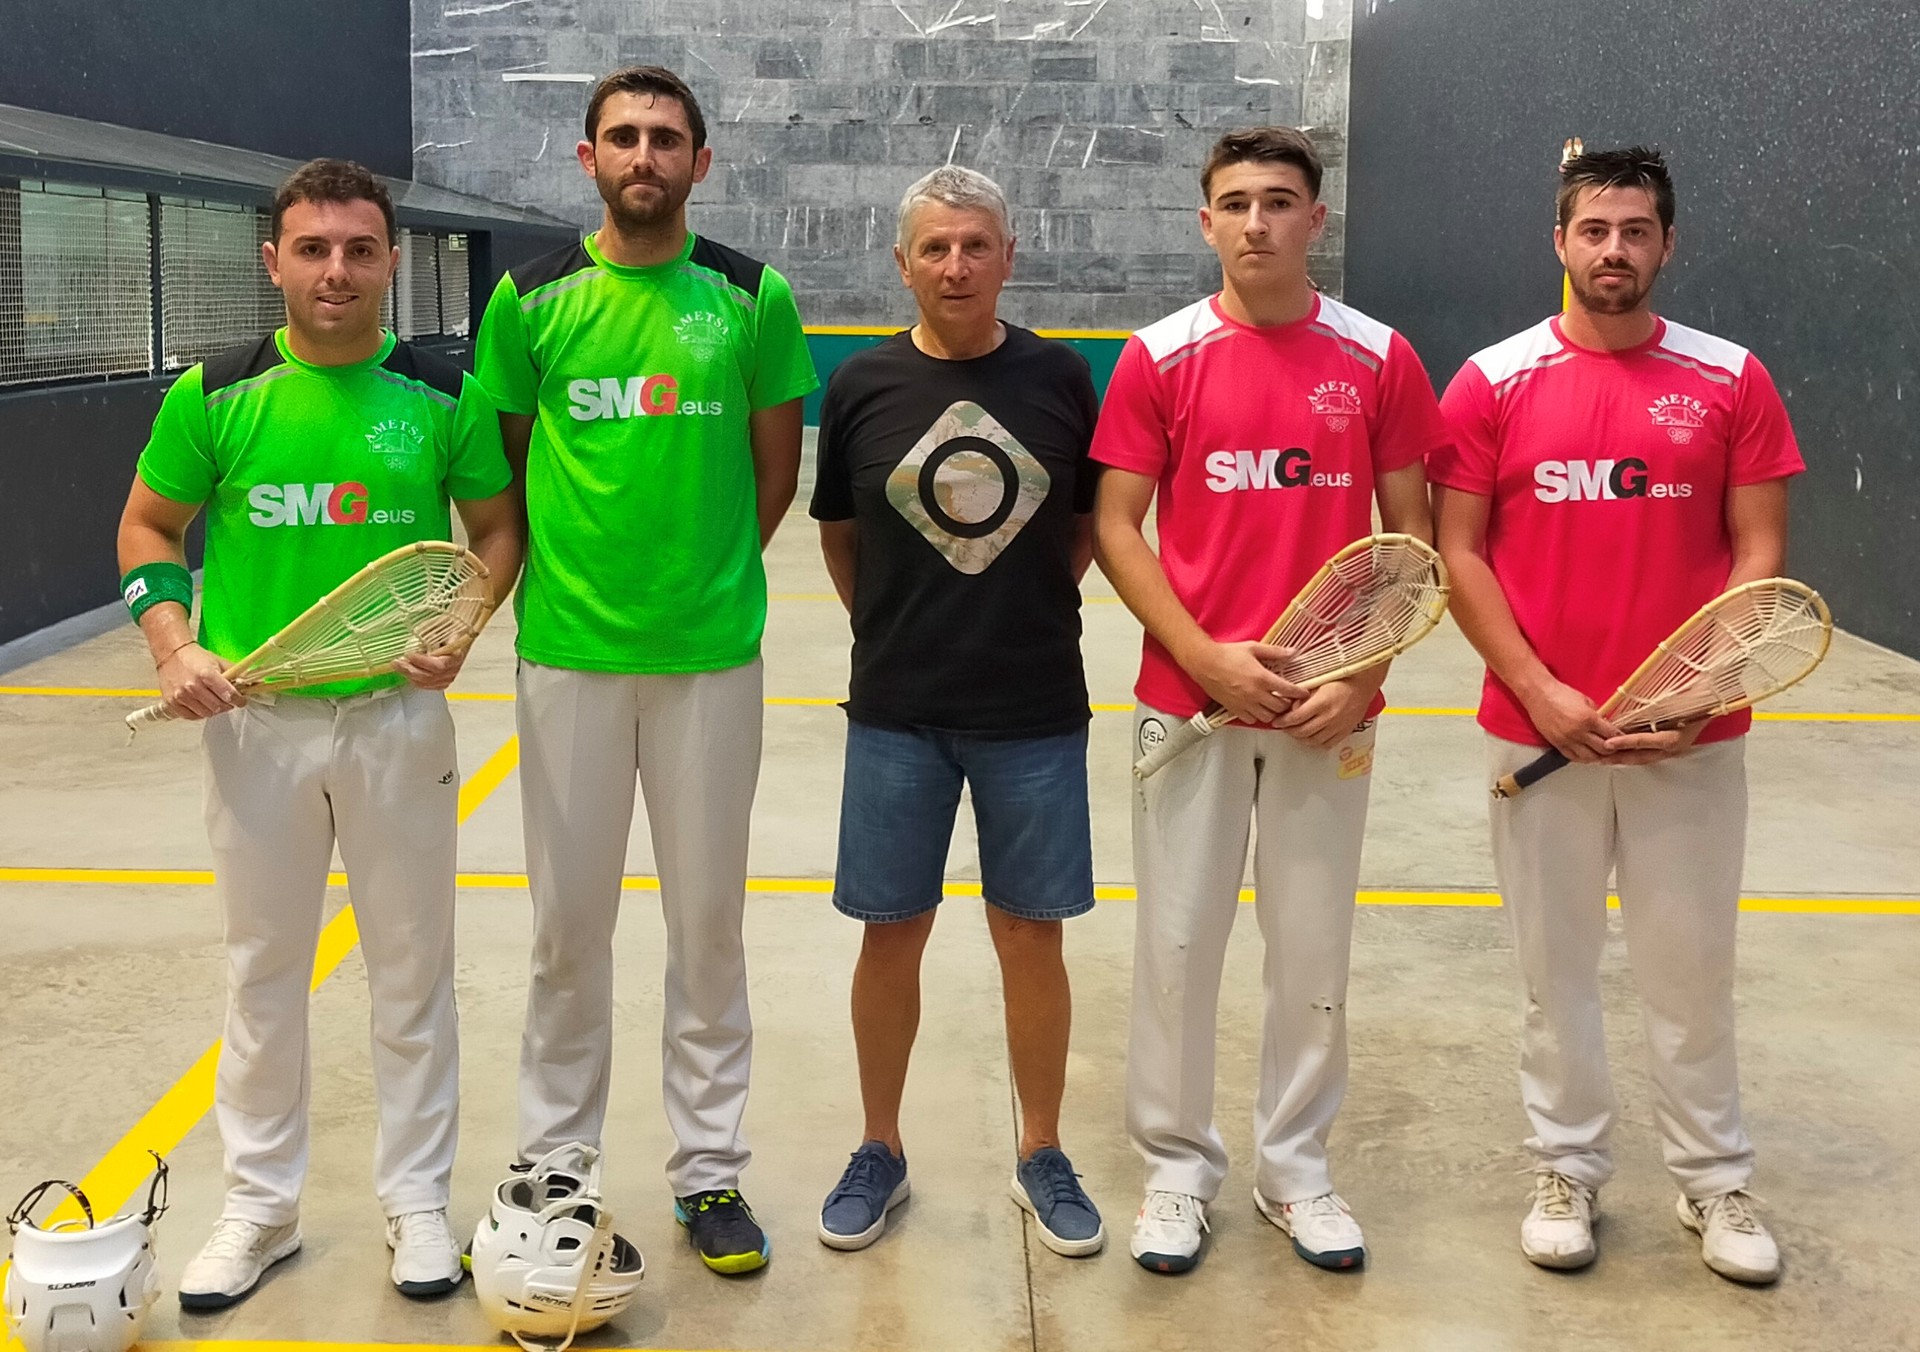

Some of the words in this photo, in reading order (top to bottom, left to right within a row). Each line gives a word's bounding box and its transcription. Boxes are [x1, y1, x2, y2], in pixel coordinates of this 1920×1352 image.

[672, 311, 729, 335] AMETSA
[1647, 393, 1708, 418] AMETSA
[364, 419, 425, 444] AMETSA
